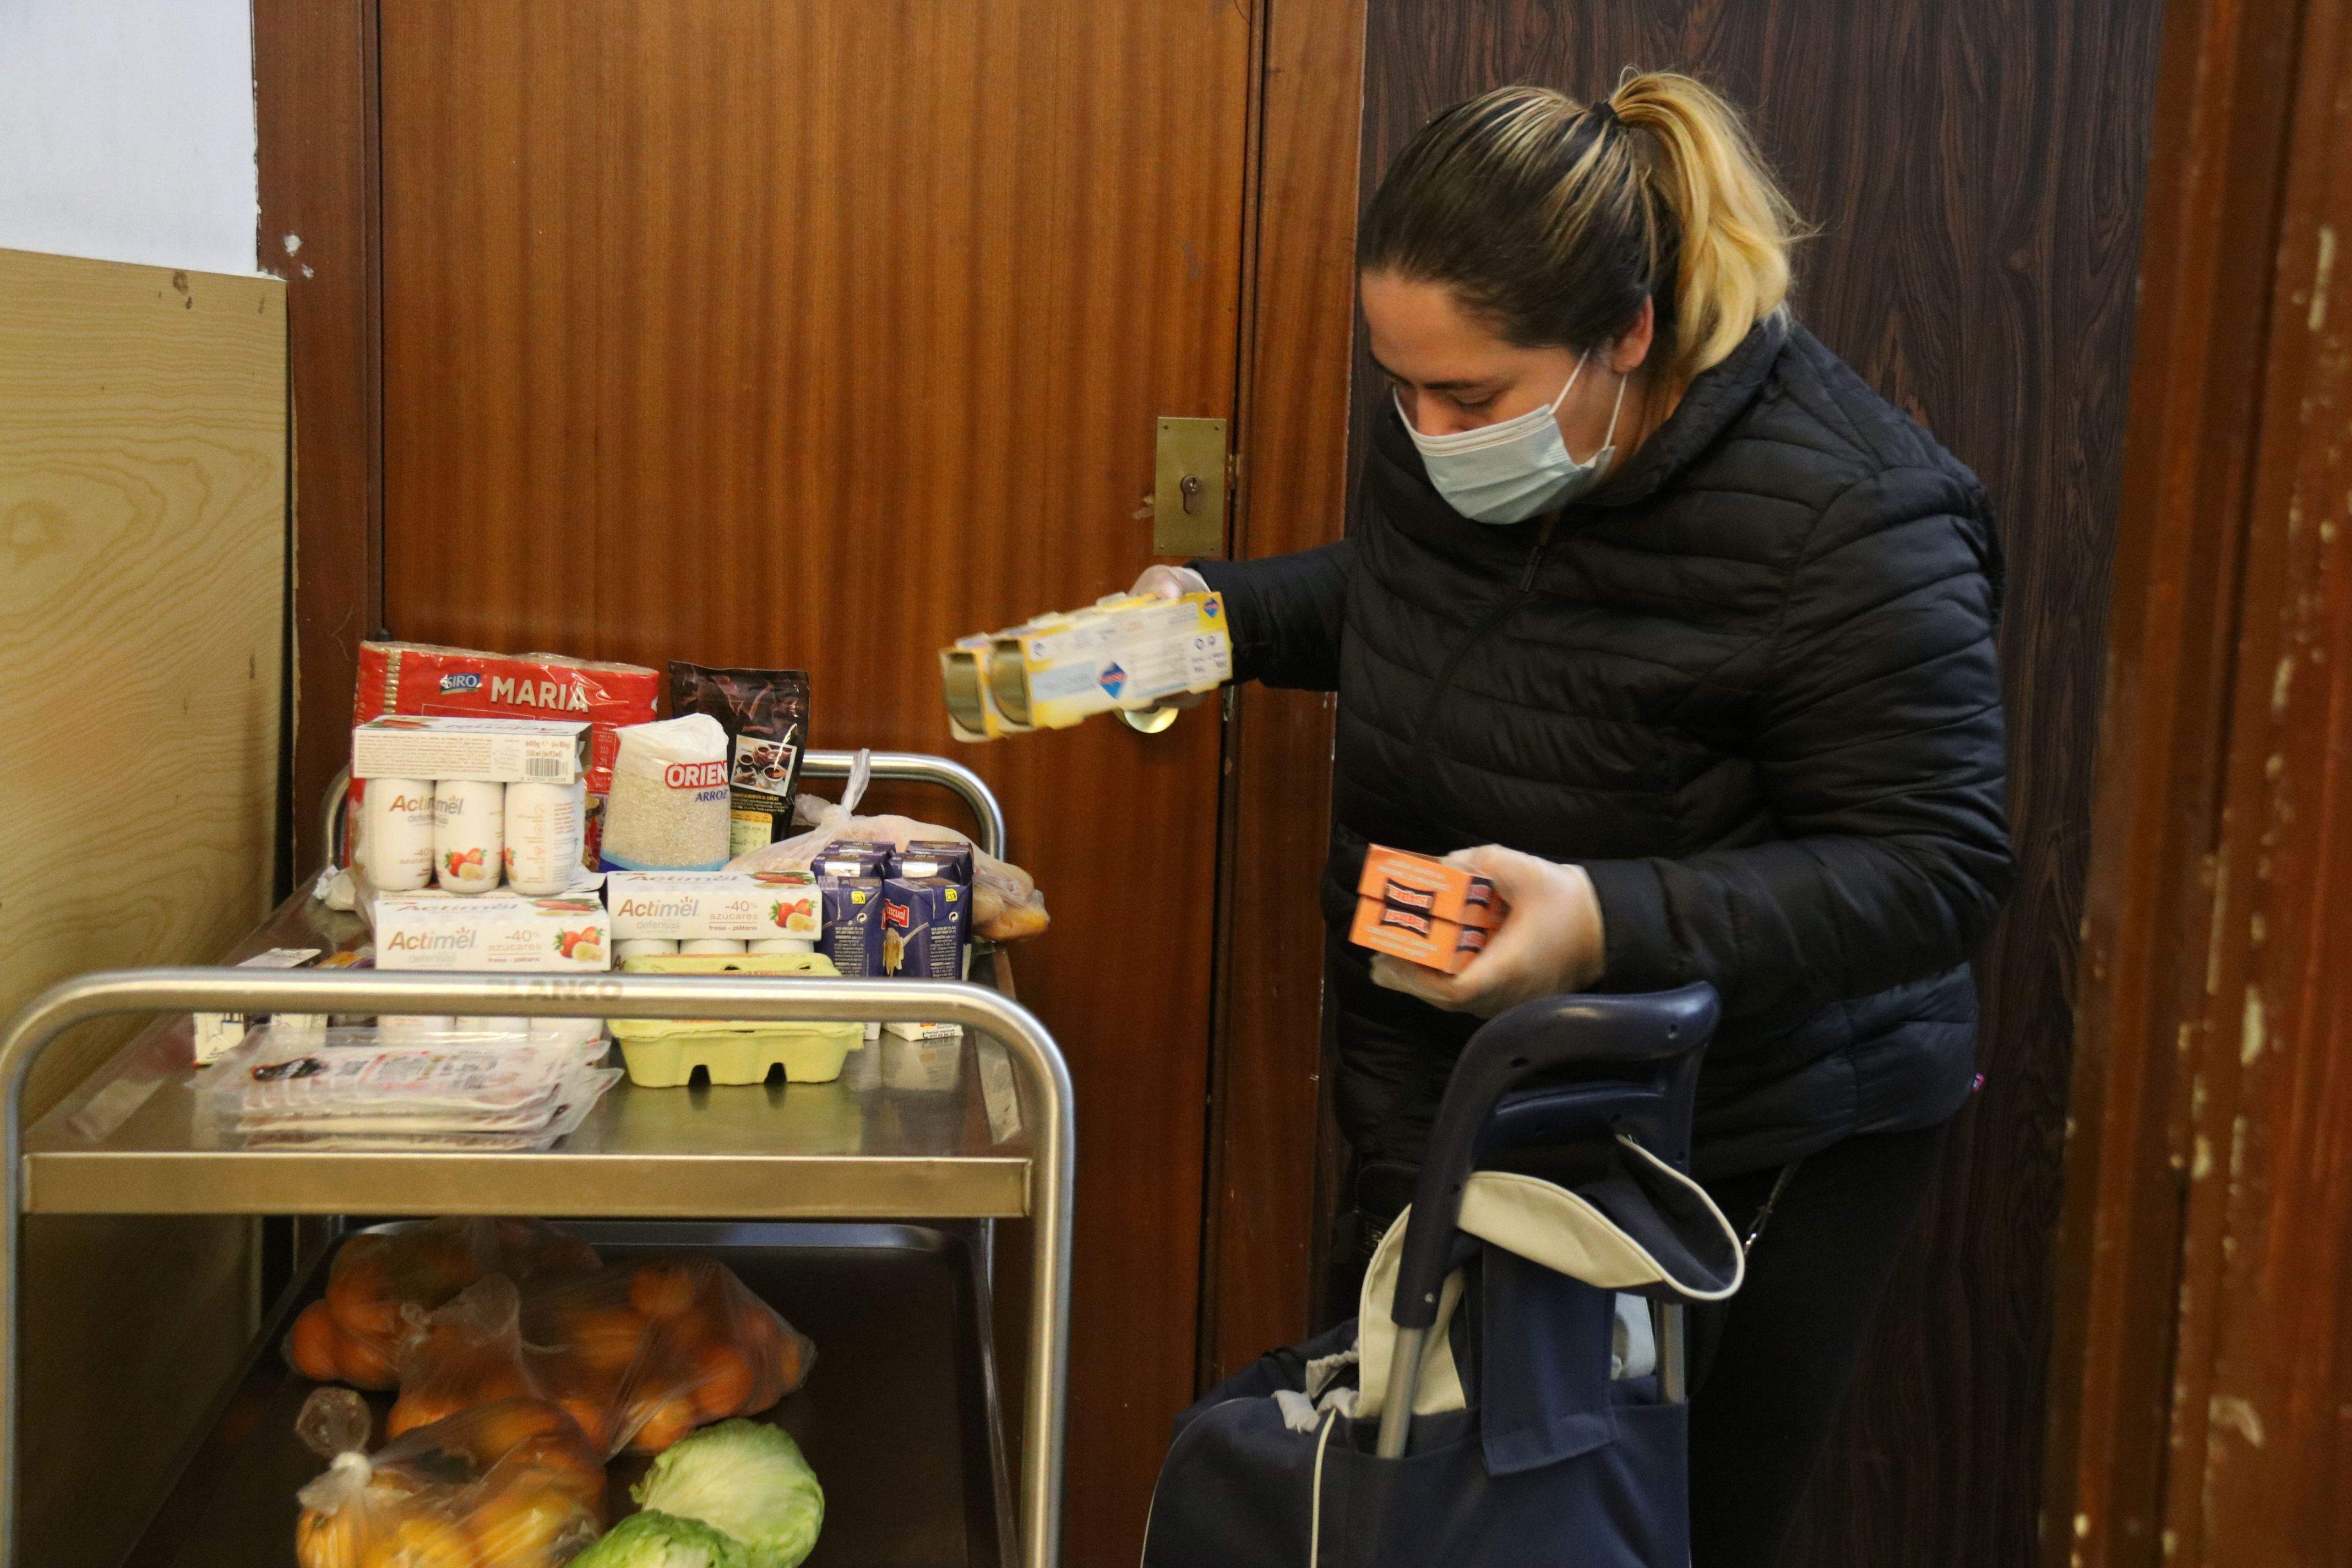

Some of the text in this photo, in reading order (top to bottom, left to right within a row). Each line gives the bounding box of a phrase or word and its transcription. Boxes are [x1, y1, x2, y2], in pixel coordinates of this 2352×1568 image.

[491, 676, 589, 712] MARIA
[695, 789, 728, 803] ARROZ
[618, 899, 699, 917] Actimel
[387, 929, 477, 950] Actimel
